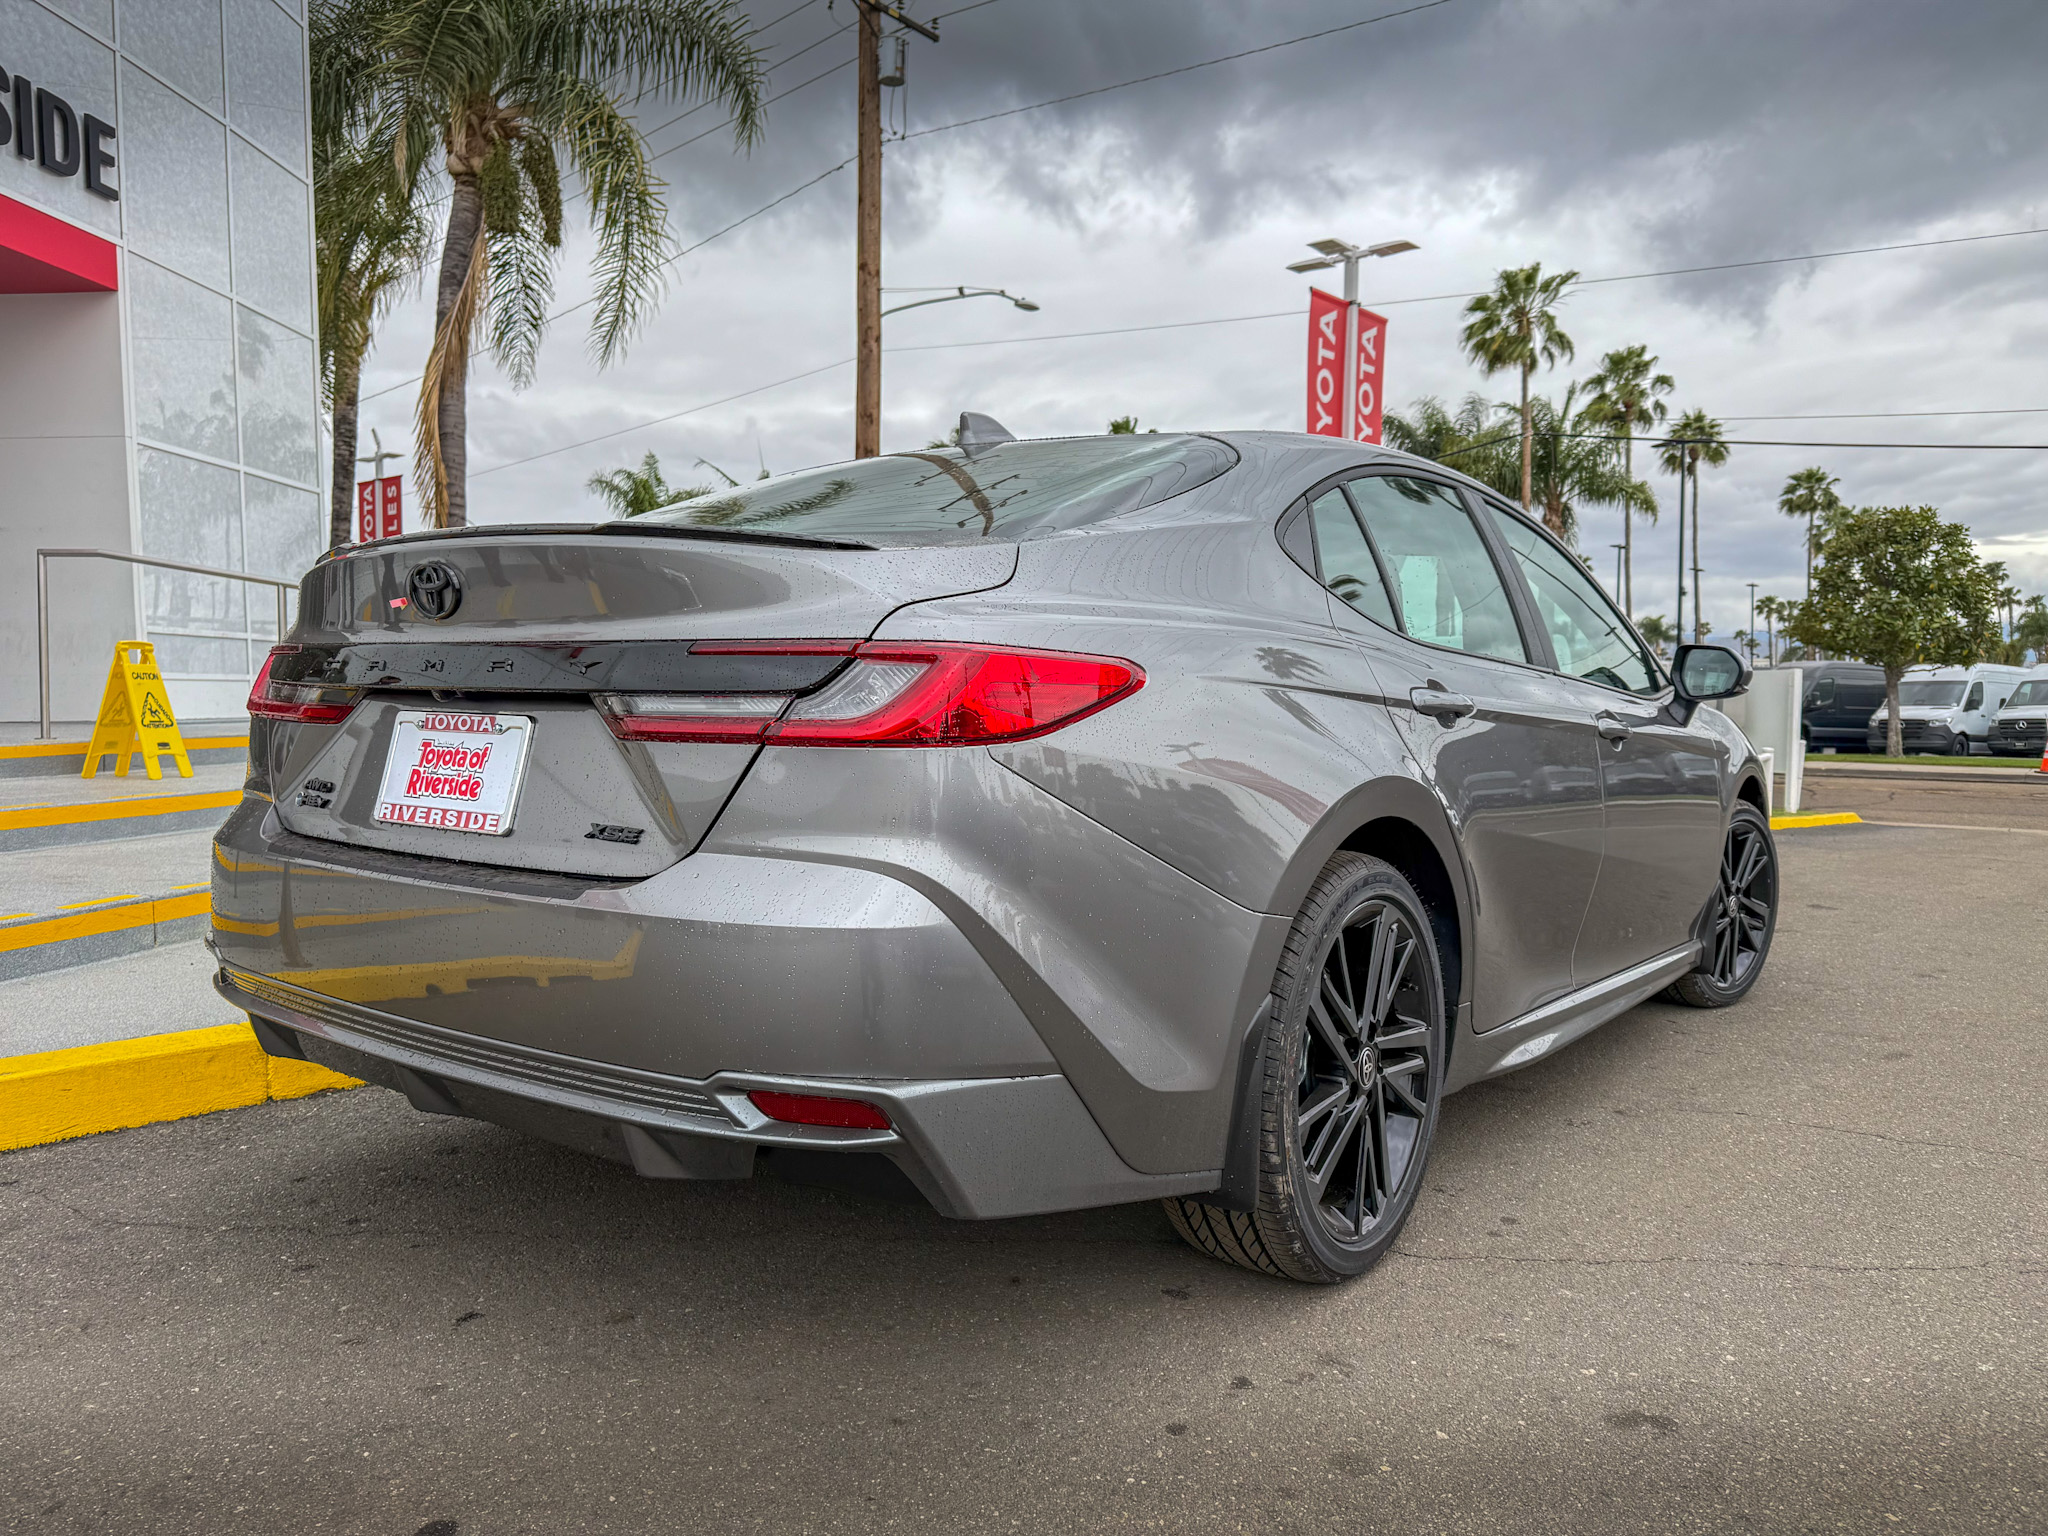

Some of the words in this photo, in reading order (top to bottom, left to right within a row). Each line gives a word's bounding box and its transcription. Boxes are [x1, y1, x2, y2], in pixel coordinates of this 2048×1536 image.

[131, 672, 159, 680] CAUTION
[426, 714, 494, 732] TOYOTA
[418, 741, 465, 771] Toyota
[468, 745, 490, 770] of
[405, 767, 482, 799] Riverside
[379, 803, 499, 832] RIVERSIDE
[584, 823, 645, 845] XSE
